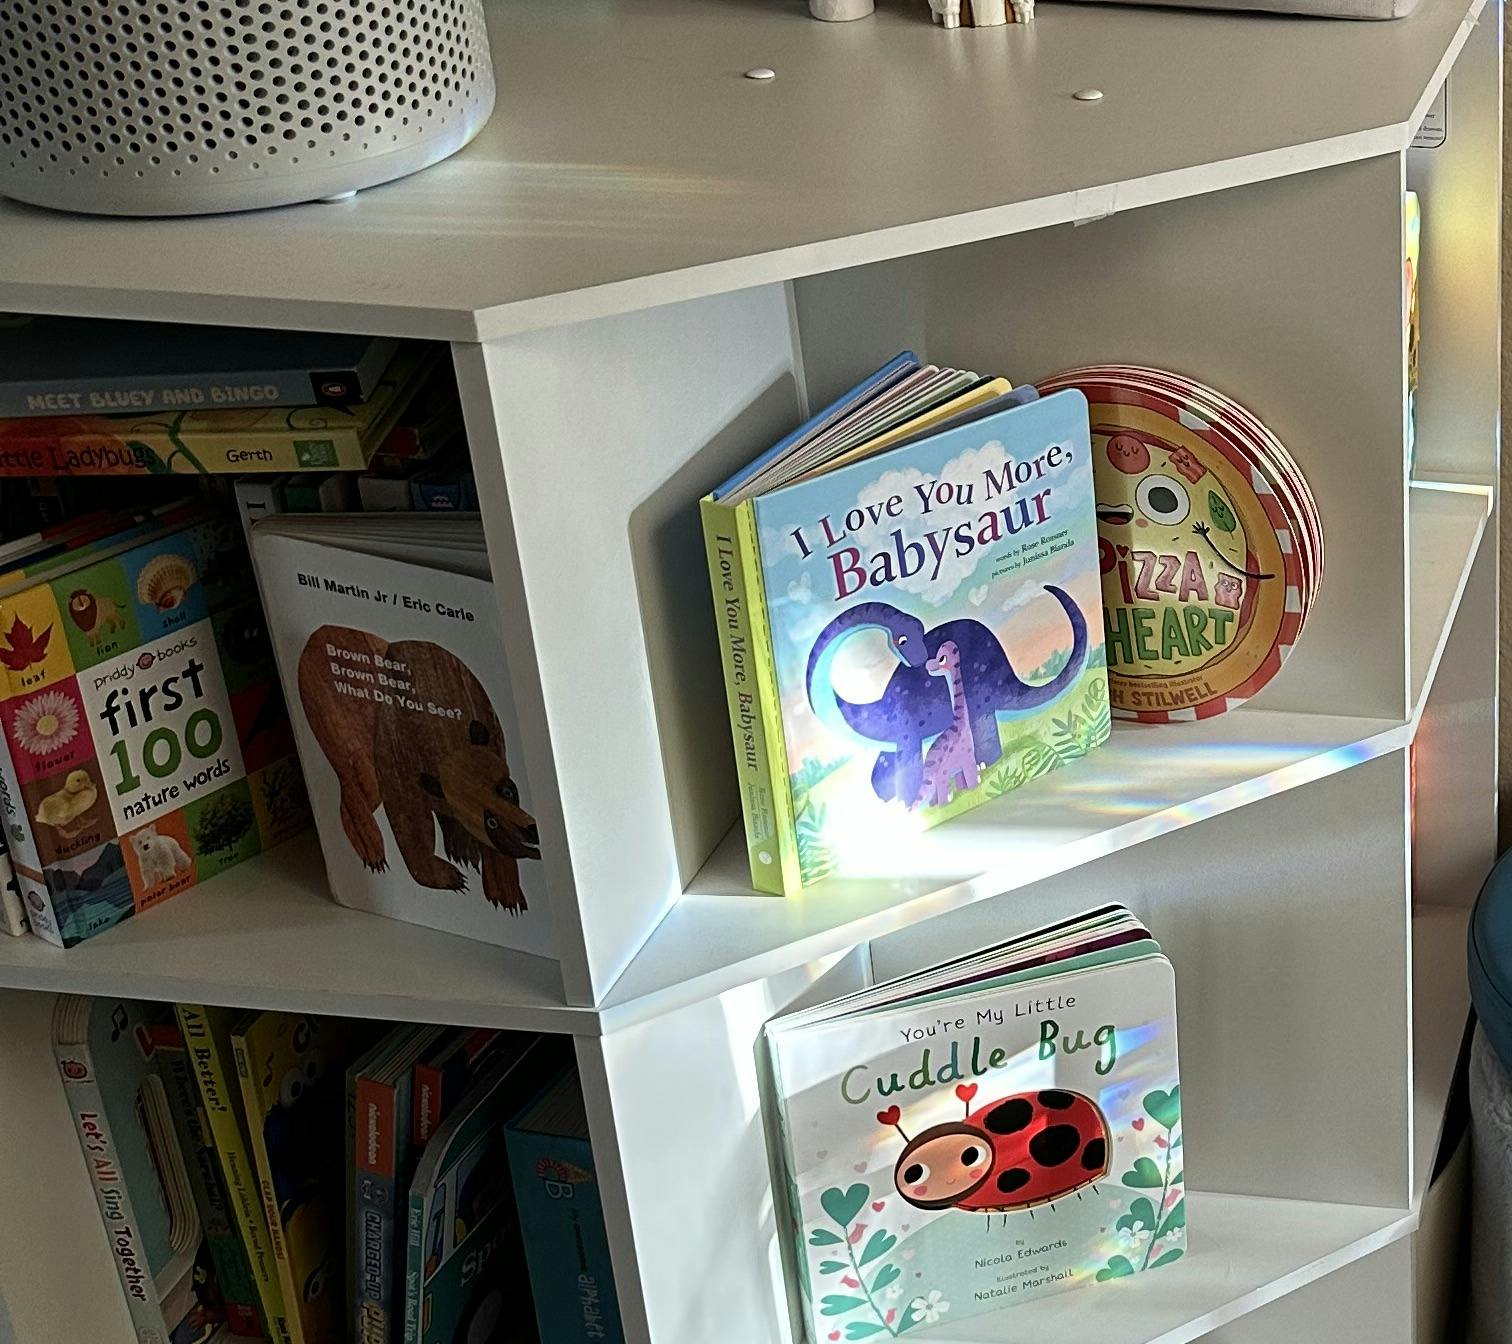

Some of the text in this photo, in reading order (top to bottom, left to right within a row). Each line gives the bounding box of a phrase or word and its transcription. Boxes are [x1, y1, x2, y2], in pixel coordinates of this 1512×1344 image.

[26, 384, 281, 411] MEET BLUEY AND BINGO
[48, 444, 156, 473] Ladybugs
[226, 447, 274, 464] Gerth
[790, 444, 1074, 561] I Love You More,
[716, 535, 732, 543] I
[826, 487, 1052, 602] Babysaur
[1021, 540, 1040, 554] Rose
[716, 545, 734, 592] Love
[297, 573, 321, 590] Bill
[324, 578, 370, 600] Martin
[374, 590, 389, 604] Jr
[402, 596, 432, 613] Eric
[435, 603, 475, 623] Carle
[723, 596, 740, 630] You
[325, 643, 412, 675] Brown Bear,
[728, 631, 747, 687] More,
[1105, 605, 1234, 666] HEART
[21, 670, 48, 689] leaf
[93, 635, 198, 692] priddy books
[330, 663, 416, 694] Brown Bear,
[100, 658, 206, 737] first
[334, 681, 463, 721] What Do You See?
[1132, 683, 1219, 707] STILWELL
[110, 708, 224, 796] 100
[736, 692, 758, 772] Babysaur
[122, 758, 232, 822] nature words
[900, 995, 1077, 1043] You're My Little
[182, 1006, 229, 1113] All Better!
[841, 1019, 1118, 1105] Cuddle Bug
[80, 1112, 106, 1153] Let's
[366, 1102, 377, 1167] nickelodeon
[93, 1156, 120, 1184] All
[100, 1187, 125, 1221] Sing
[113, 1225, 148, 1304] Together
[365, 1209, 383, 1302] CHARGED-UP
[975, 1239, 1068, 1269] Nicola Edwards
[974, 1268, 1074, 1301] Natalie Marshall
